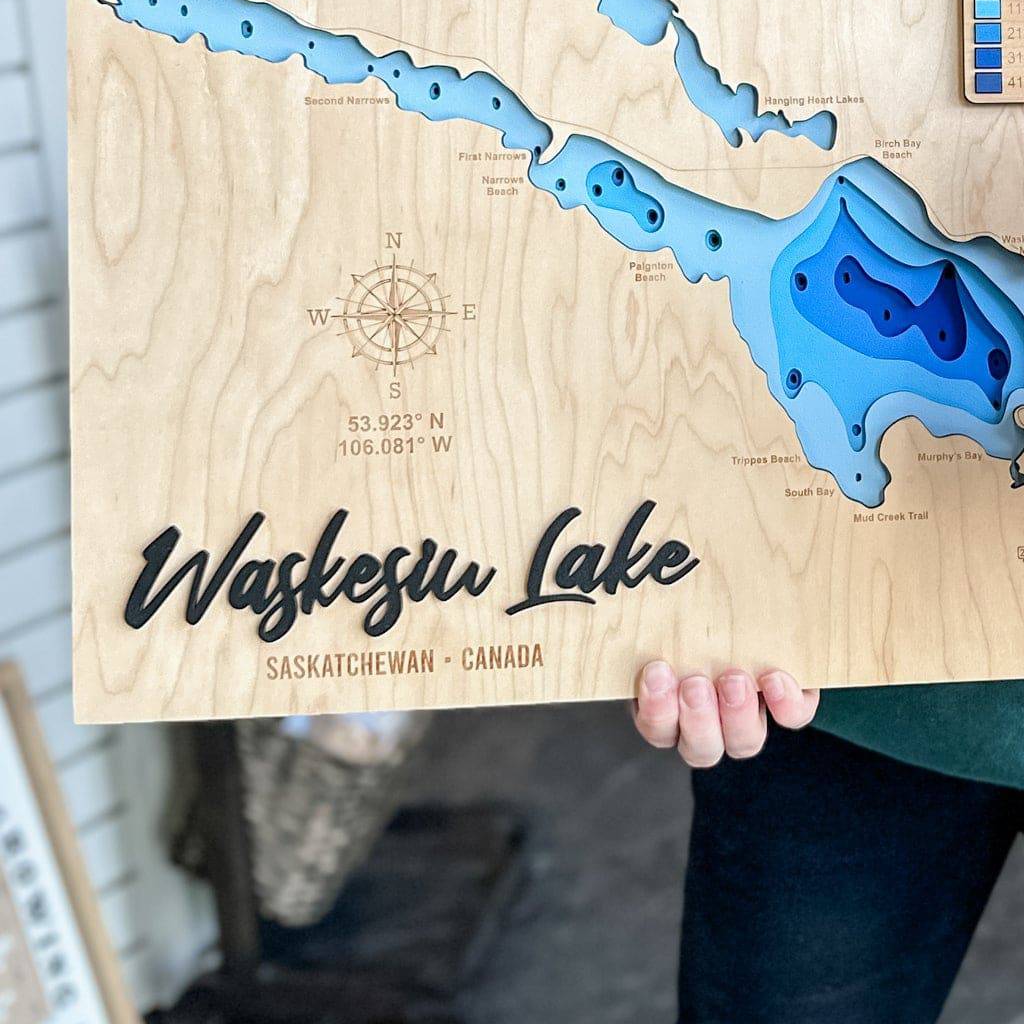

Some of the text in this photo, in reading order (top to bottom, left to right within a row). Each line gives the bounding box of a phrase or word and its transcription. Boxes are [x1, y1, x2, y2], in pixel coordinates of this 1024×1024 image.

[304, 96, 390, 106] Second Narrows
[765, 95, 865, 106] Hanging Heart Lakes
[875, 139, 921, 149] Birch Bay
[458, 152, 527, 161] First Narrows
[883, 150, 912, 159] Beach
[482, 176, 524, 185] Narrows
[487, 187, 519, 196] Beach
[385, 232, 402, 249] N
[629, 262, 674, 272] Paignton
[635, 273, 666, 282] Beach
[306, 309, 331, 326] W
[462, 303, 476, 321] E
[389, 382, 401, 399] S
[430, 412, 444, 430] N
[432, 435, 453, 453] W
[731, 454, 801, 466] Trippes Beach
[917, 451, 983, 463] Murphy's Bay
[784, 487, 835, 499] South Bay
[853, 511, 929, 523] Mud Creek Trail
[123, 499, 701, 643] Waskesiu Lake
[267, 642, 544, 680] SASKATCHEWAN CANADA
